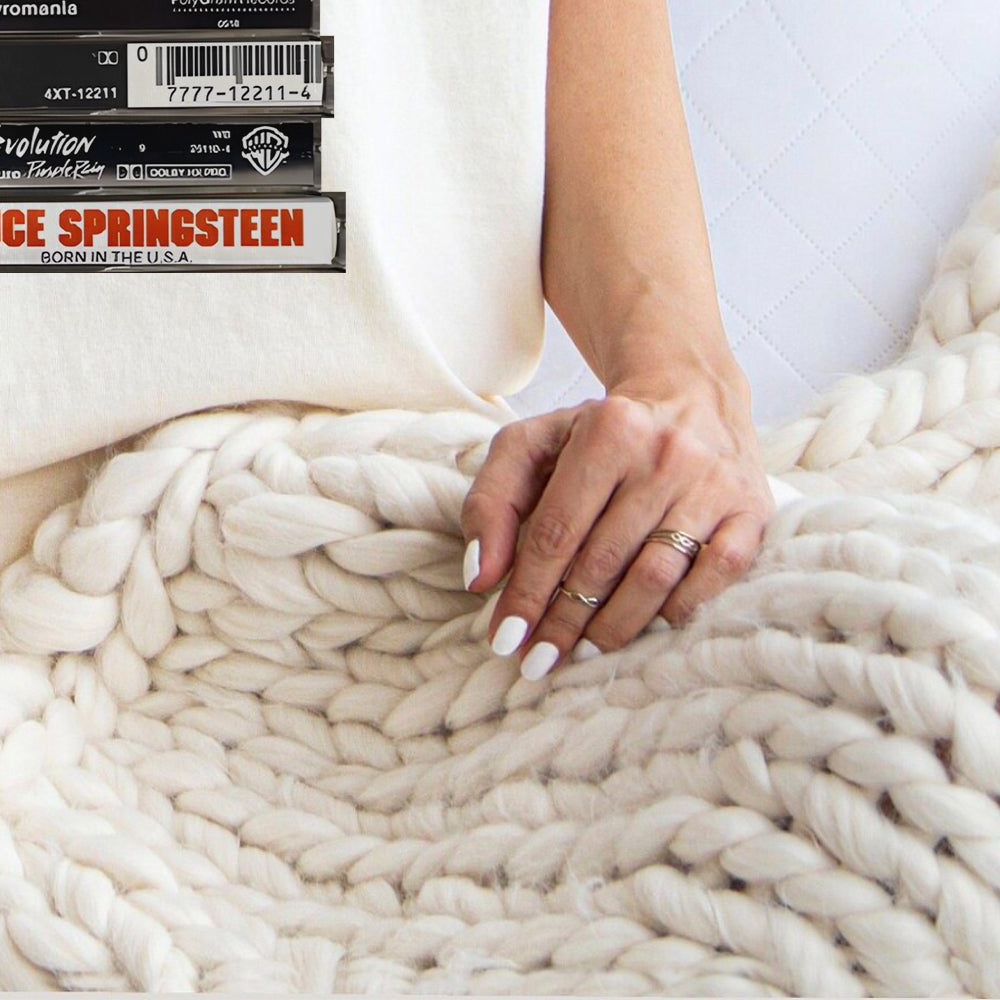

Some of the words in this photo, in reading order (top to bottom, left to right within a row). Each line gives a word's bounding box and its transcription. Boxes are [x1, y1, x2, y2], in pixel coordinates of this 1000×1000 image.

[44, 87, 117, 100] 4XT-12211
[167, 85, 311, 103] 7777-12211-4
[58, 208, 304, 247] SPRINGSTEEN
[41, 251, 87, 263] BORN
[91, 251, 107, 262] IN
[112, 251, 143, 263] THE
